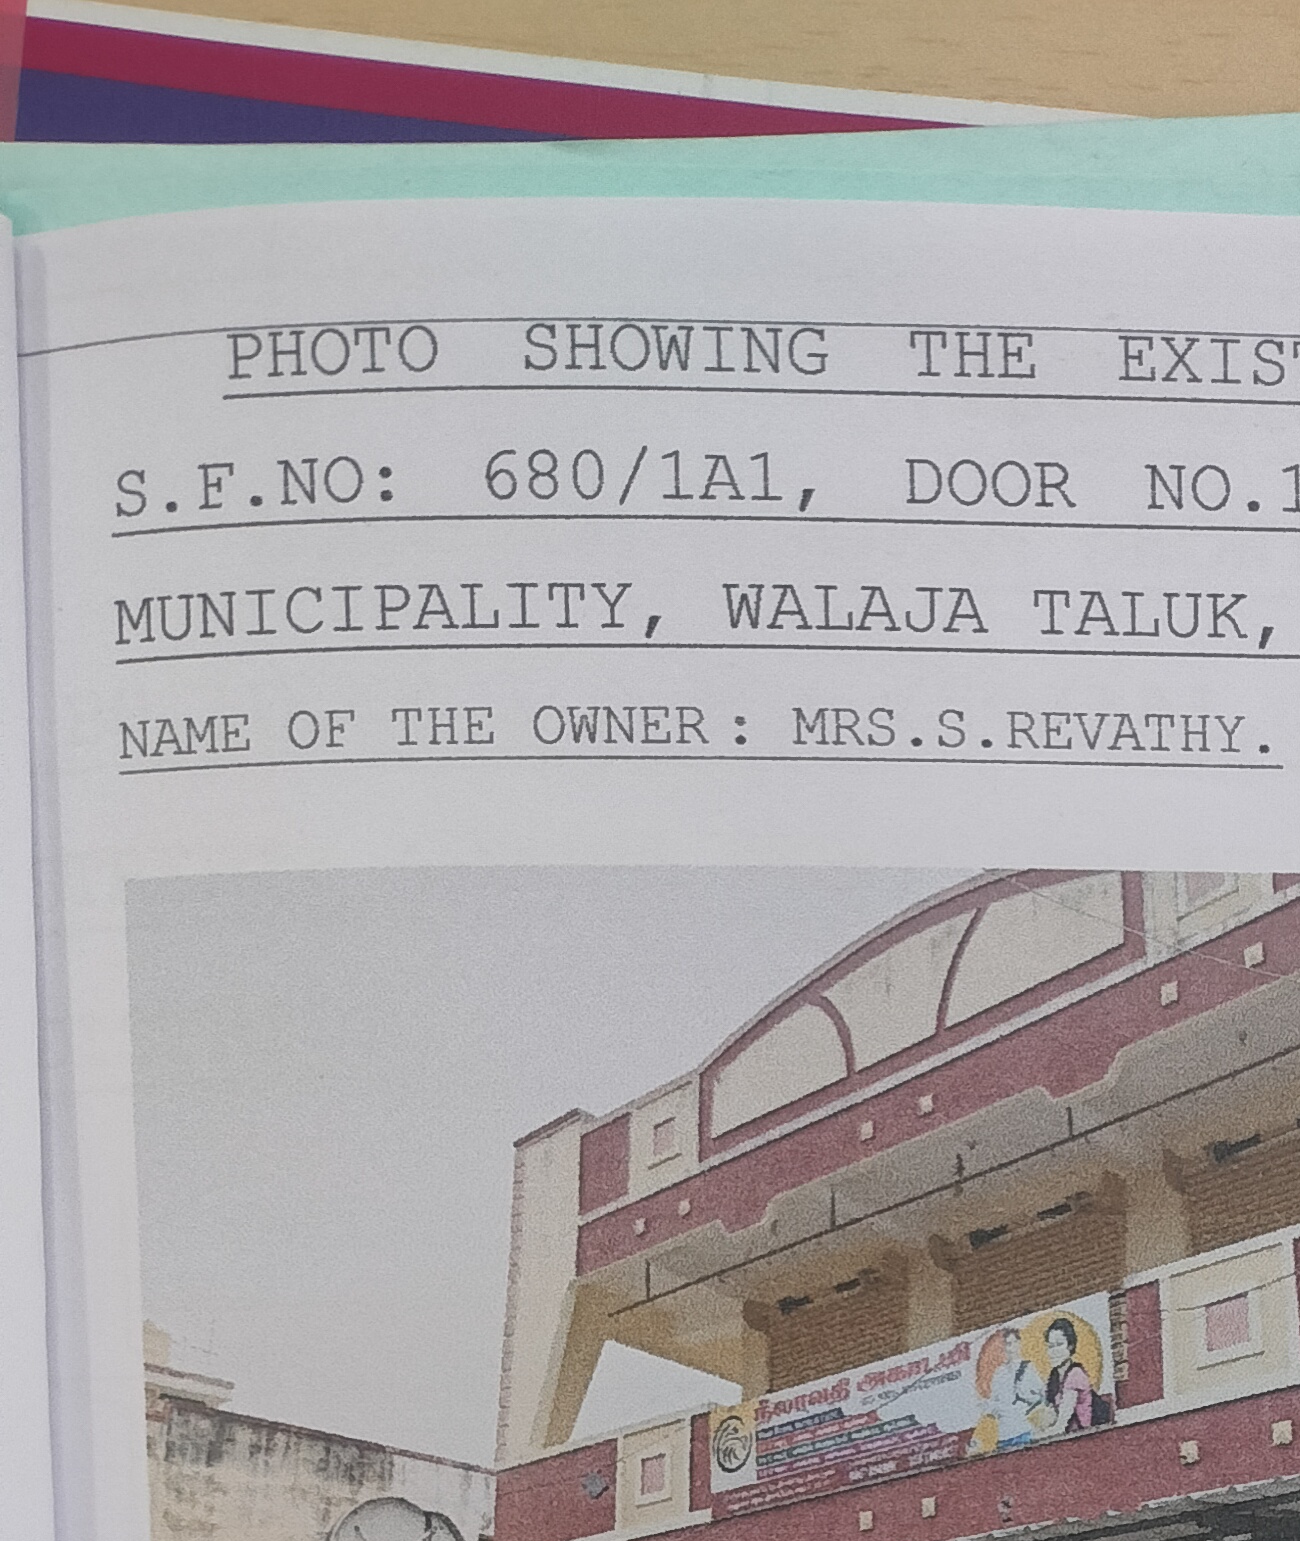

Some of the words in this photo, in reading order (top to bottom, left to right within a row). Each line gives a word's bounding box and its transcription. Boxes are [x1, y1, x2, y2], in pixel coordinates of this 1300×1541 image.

[228, 323, 439, 380] PHOTO
[524, 323, 829, 379] SHOWING
[909, 330, 1036, 379] THE
[116, 458, 395, 517] S.F.NO:
[485, 445, 815, 512] 680/1A1,
[905, 459, 1076, 508] DOOR
[114, 582, 666, 644] MUNICIPALITY,
[722, 583, 989, 633] WALAJA
[1033, 590, 1274, 649] TALUK,
[119, 714, 250, 759] NAME
[288, 709, 355, 750] OF
[392, 707, 494, 746] THE
[533, 705, 709, 745] OWNER
[792, 707, 1270, 754] MRS.S.REVATHY.
